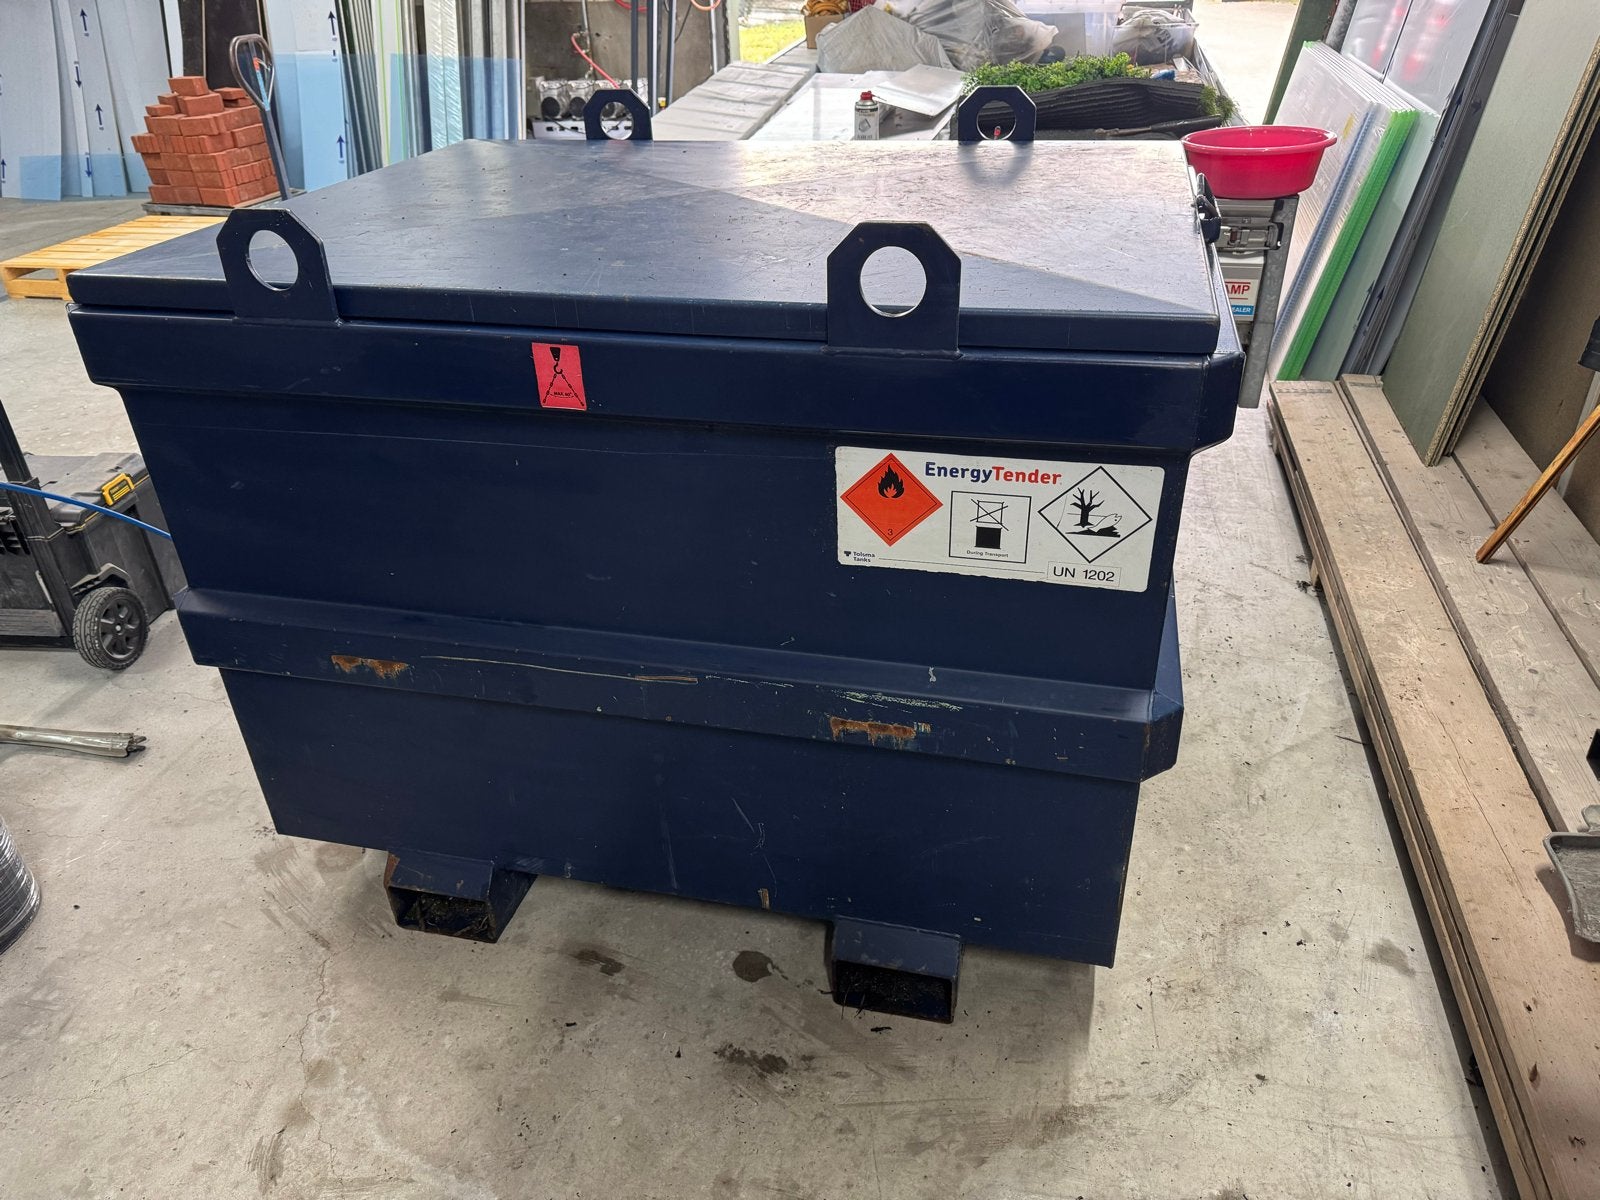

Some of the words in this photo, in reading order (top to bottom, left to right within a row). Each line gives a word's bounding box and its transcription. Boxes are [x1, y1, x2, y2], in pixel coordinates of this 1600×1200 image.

[924, 460, 1063, 485] EnergyTender
[887, 528, 893, 536] 3
[1053, 565, 1076, 578] UN
[1082, 569, 1115, 582] 1202
